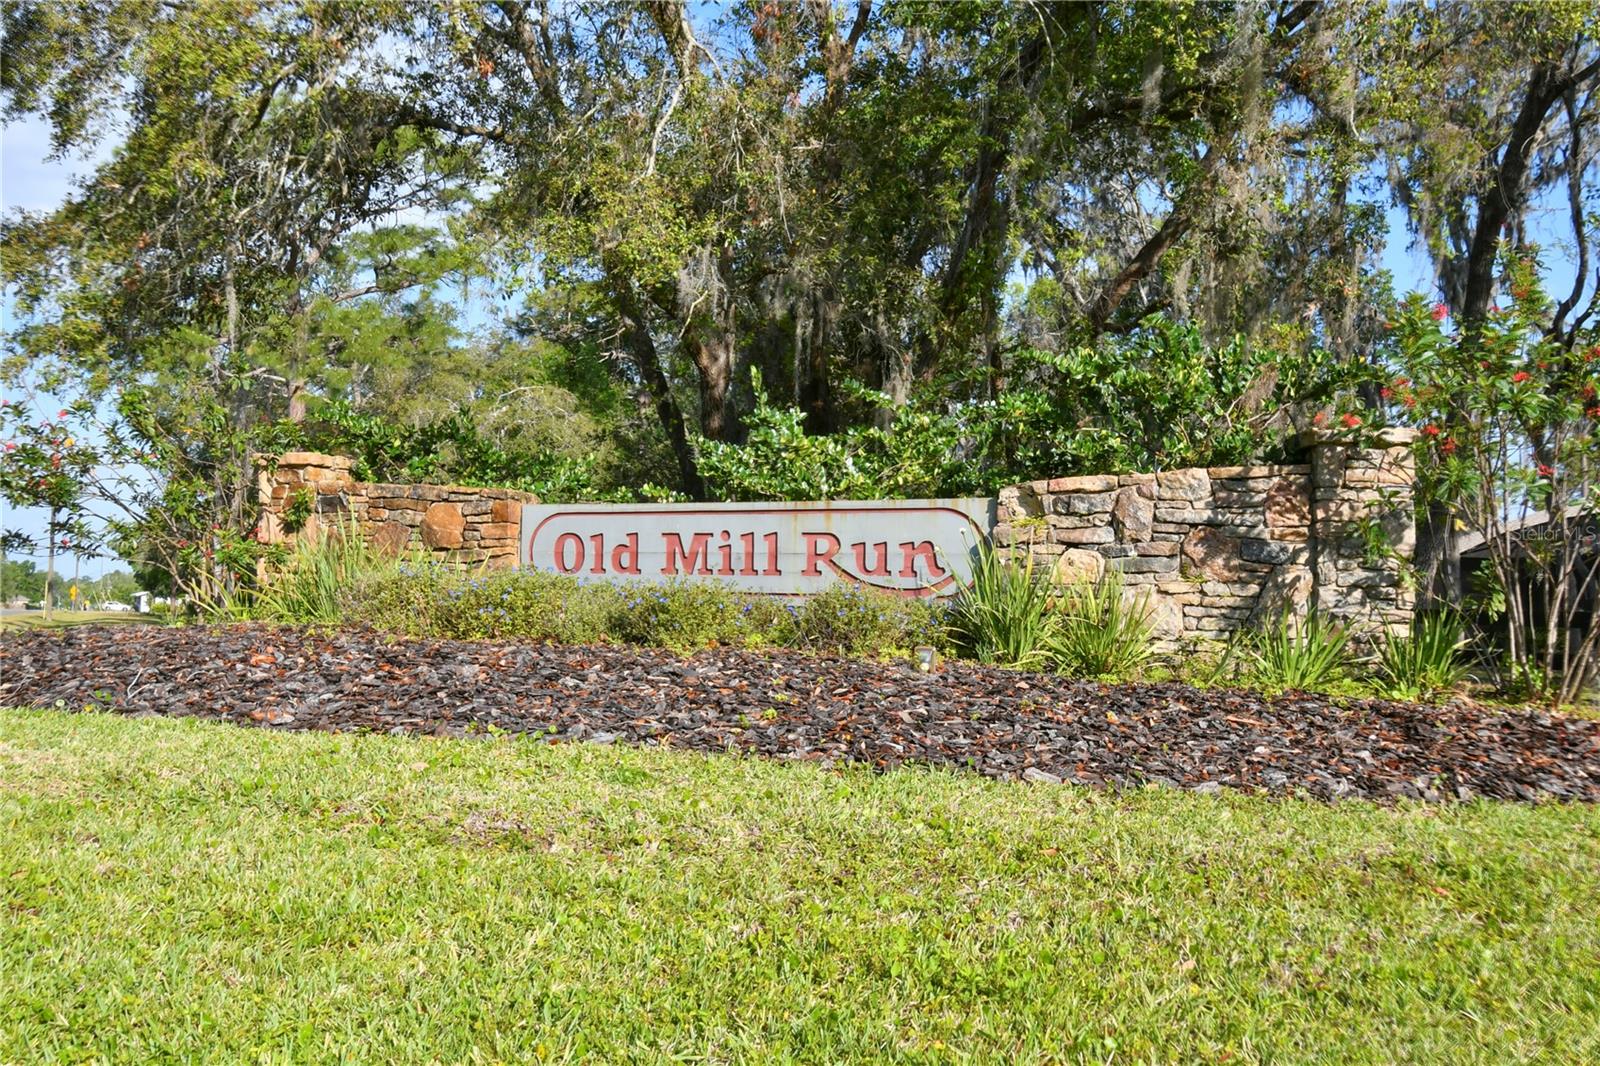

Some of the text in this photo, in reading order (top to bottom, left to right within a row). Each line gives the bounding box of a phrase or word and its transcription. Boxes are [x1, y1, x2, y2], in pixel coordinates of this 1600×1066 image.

[553, 530, 957, 591] Old Mill Run
